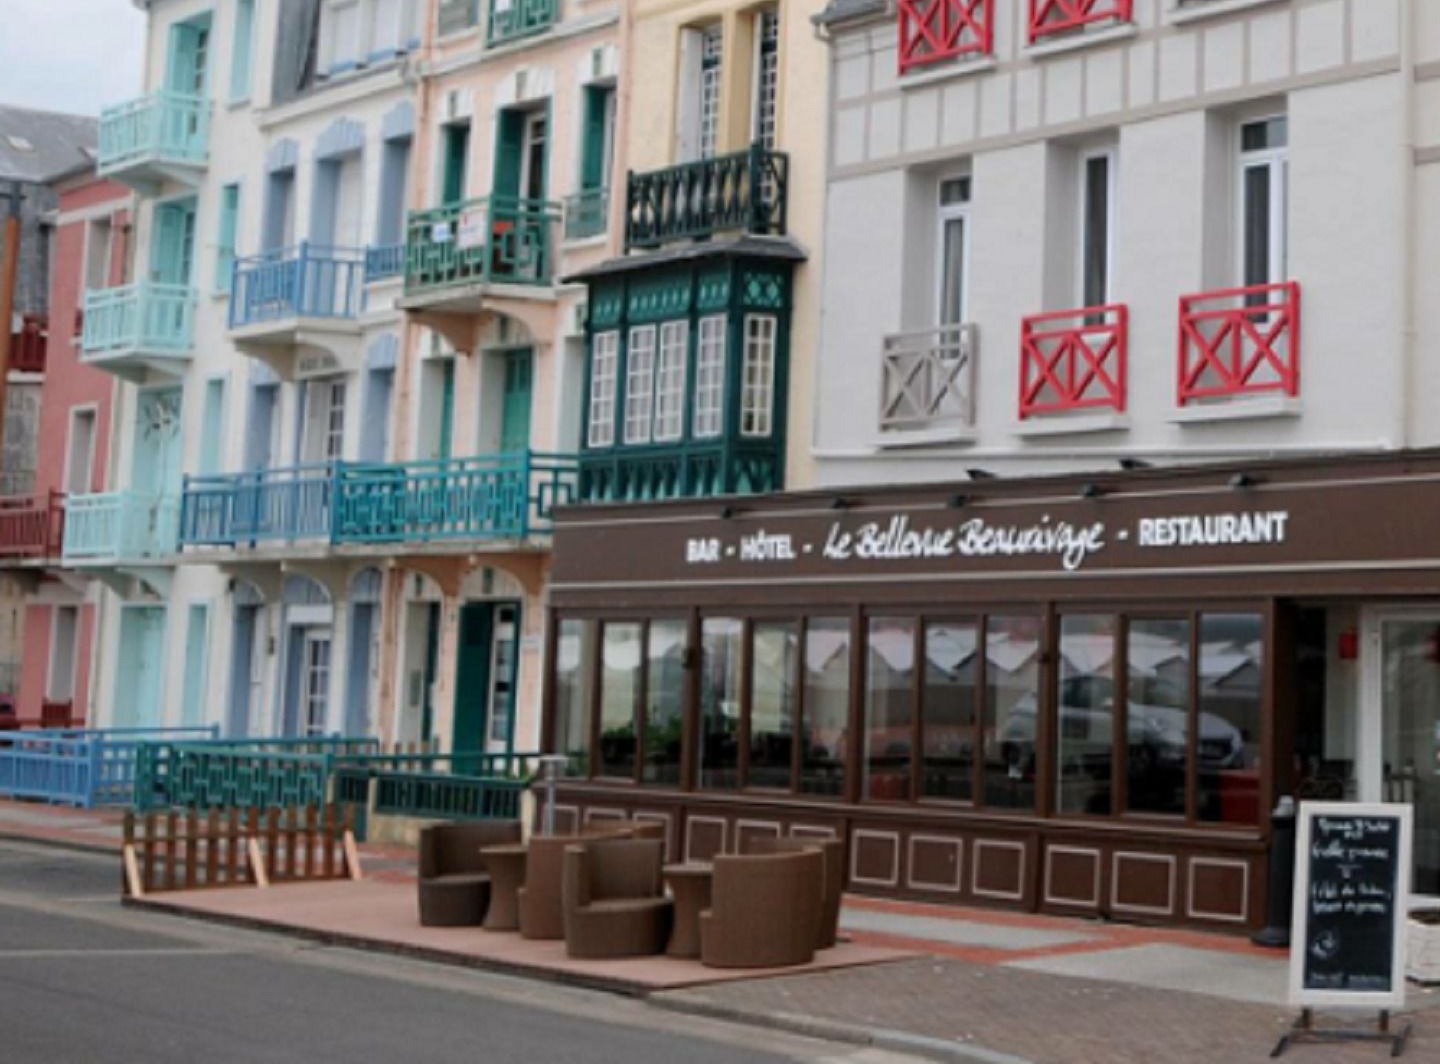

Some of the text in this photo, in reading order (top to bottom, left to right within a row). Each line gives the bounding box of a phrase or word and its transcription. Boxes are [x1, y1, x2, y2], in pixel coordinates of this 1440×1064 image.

[686, 538, 721, 562] BAR
[823, 521, 852, 559] Le
[855, 513, 954, 559] Bellevue
[1138, 510, 1288, 546] RESTAURANT
